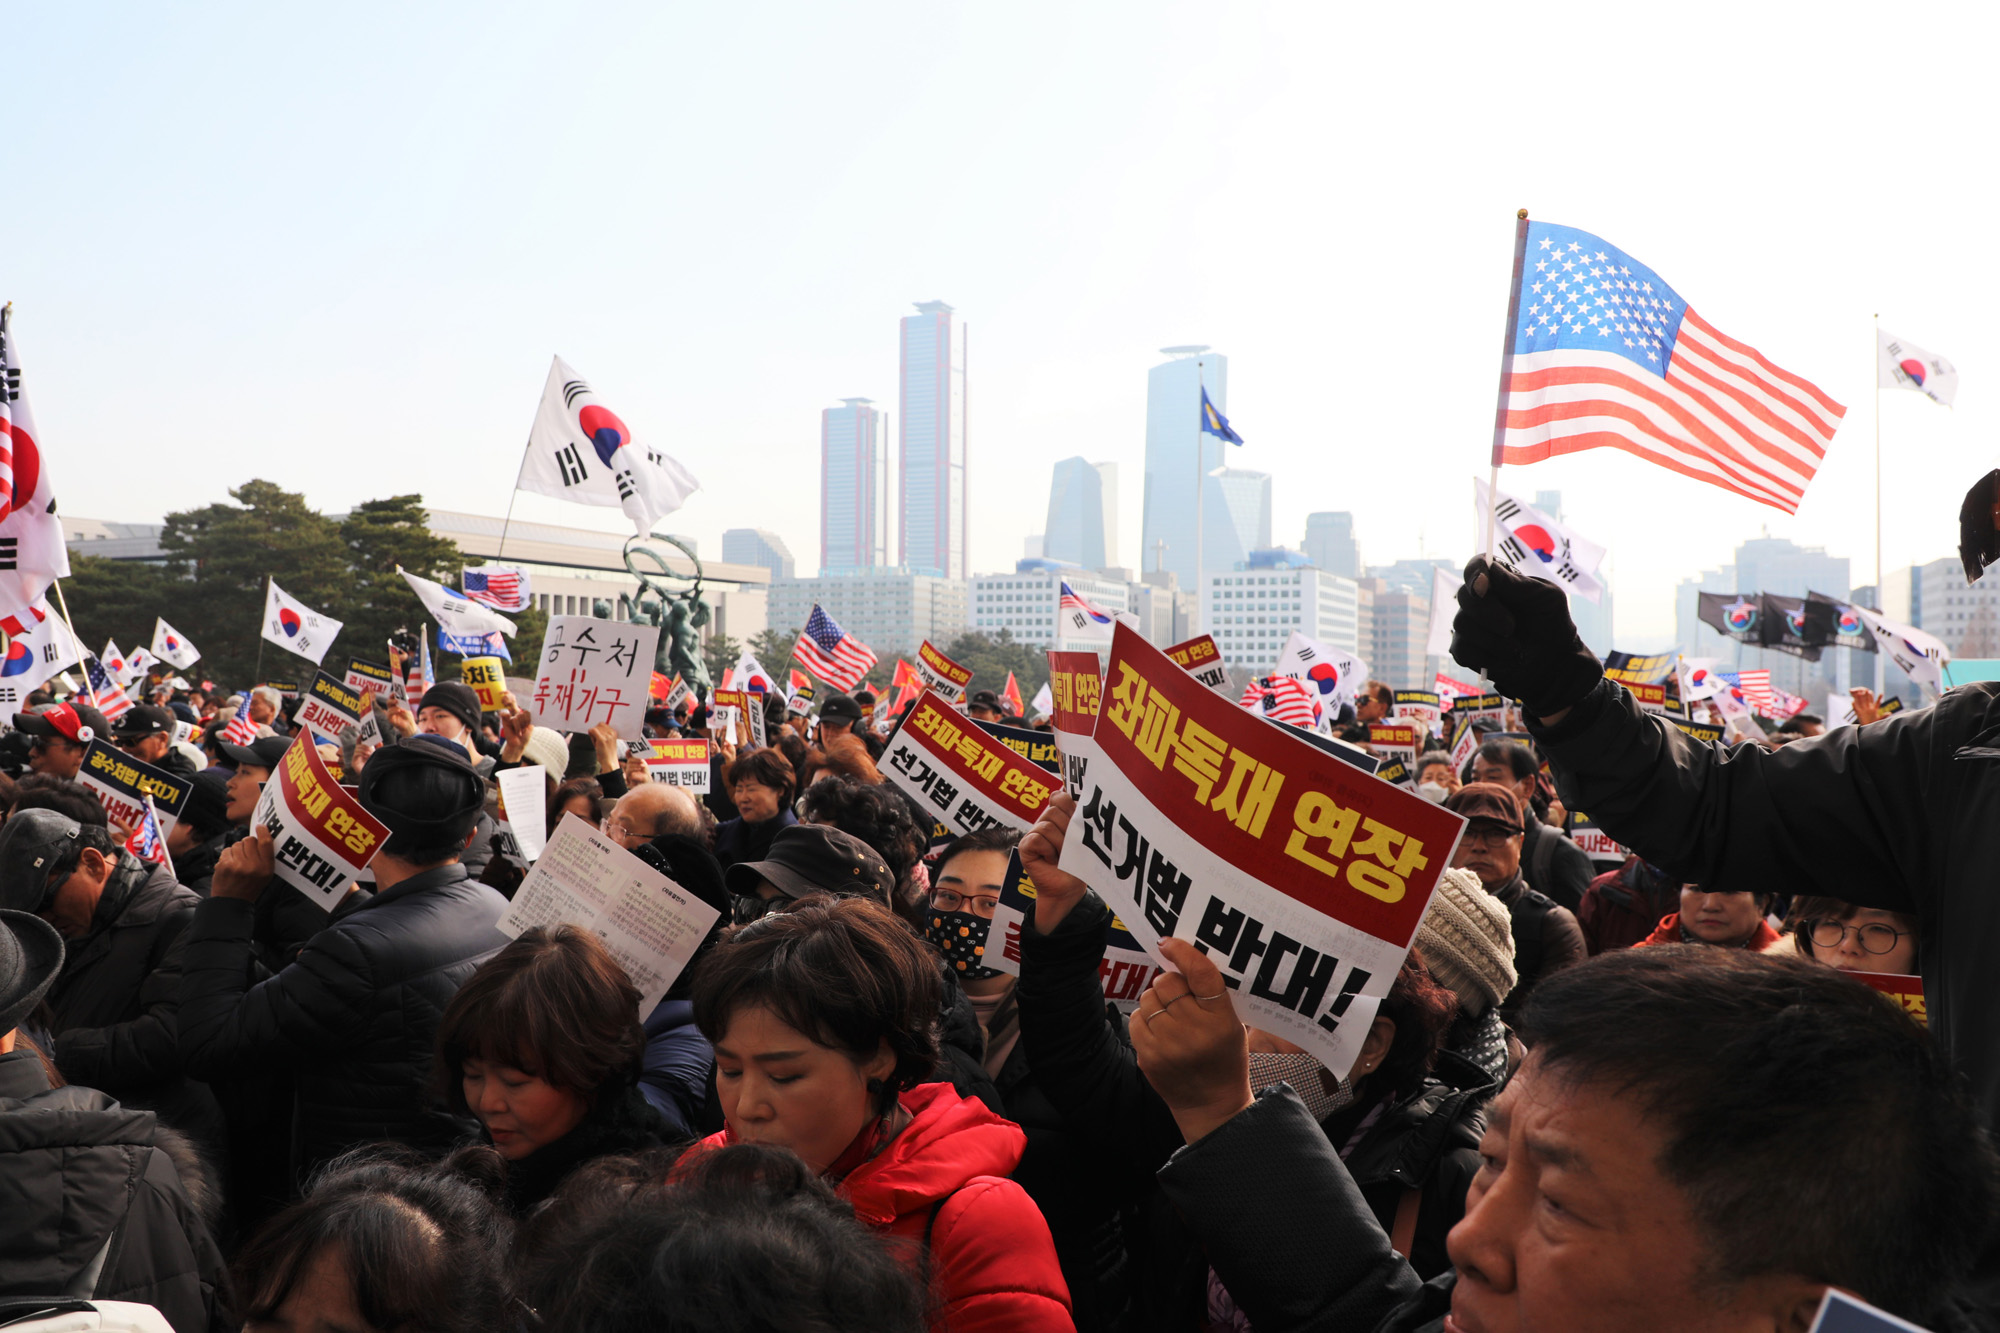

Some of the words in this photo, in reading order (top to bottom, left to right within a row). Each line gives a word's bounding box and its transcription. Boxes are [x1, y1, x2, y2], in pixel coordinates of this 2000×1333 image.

[548, 625, 639, 678] 공수처
[1190, 640, 1215, 661] 연장
[533, 676, 630, 725] 독재기구
[935, 680, 959, 699] 반대!
[1075, 673, 1100, 716] 연장
[90, 750, 140, 788] 공수처법
[136, 774, 180, 805] 날치기
[682, 771, 707, 786] 반대!
[686, 744, 707, 759] 연장
[889, 745, 960, 812] 선거법
[911, 703, 1006, 783] 좌파독재
[998, 768, 1051, 810] 연장
[285, 737, 333, 820] 좌파독재
[323, 806, 376, 855] 연장
[1107, 659, 1286, 840] 좌파독재
[1283, 791, 1429, 904] 연장
[275, 835, 347, 894] 반대!
[1081, 784, 1193, 940] 선거법
[1192, 894, 1373, 1034] 반대!
